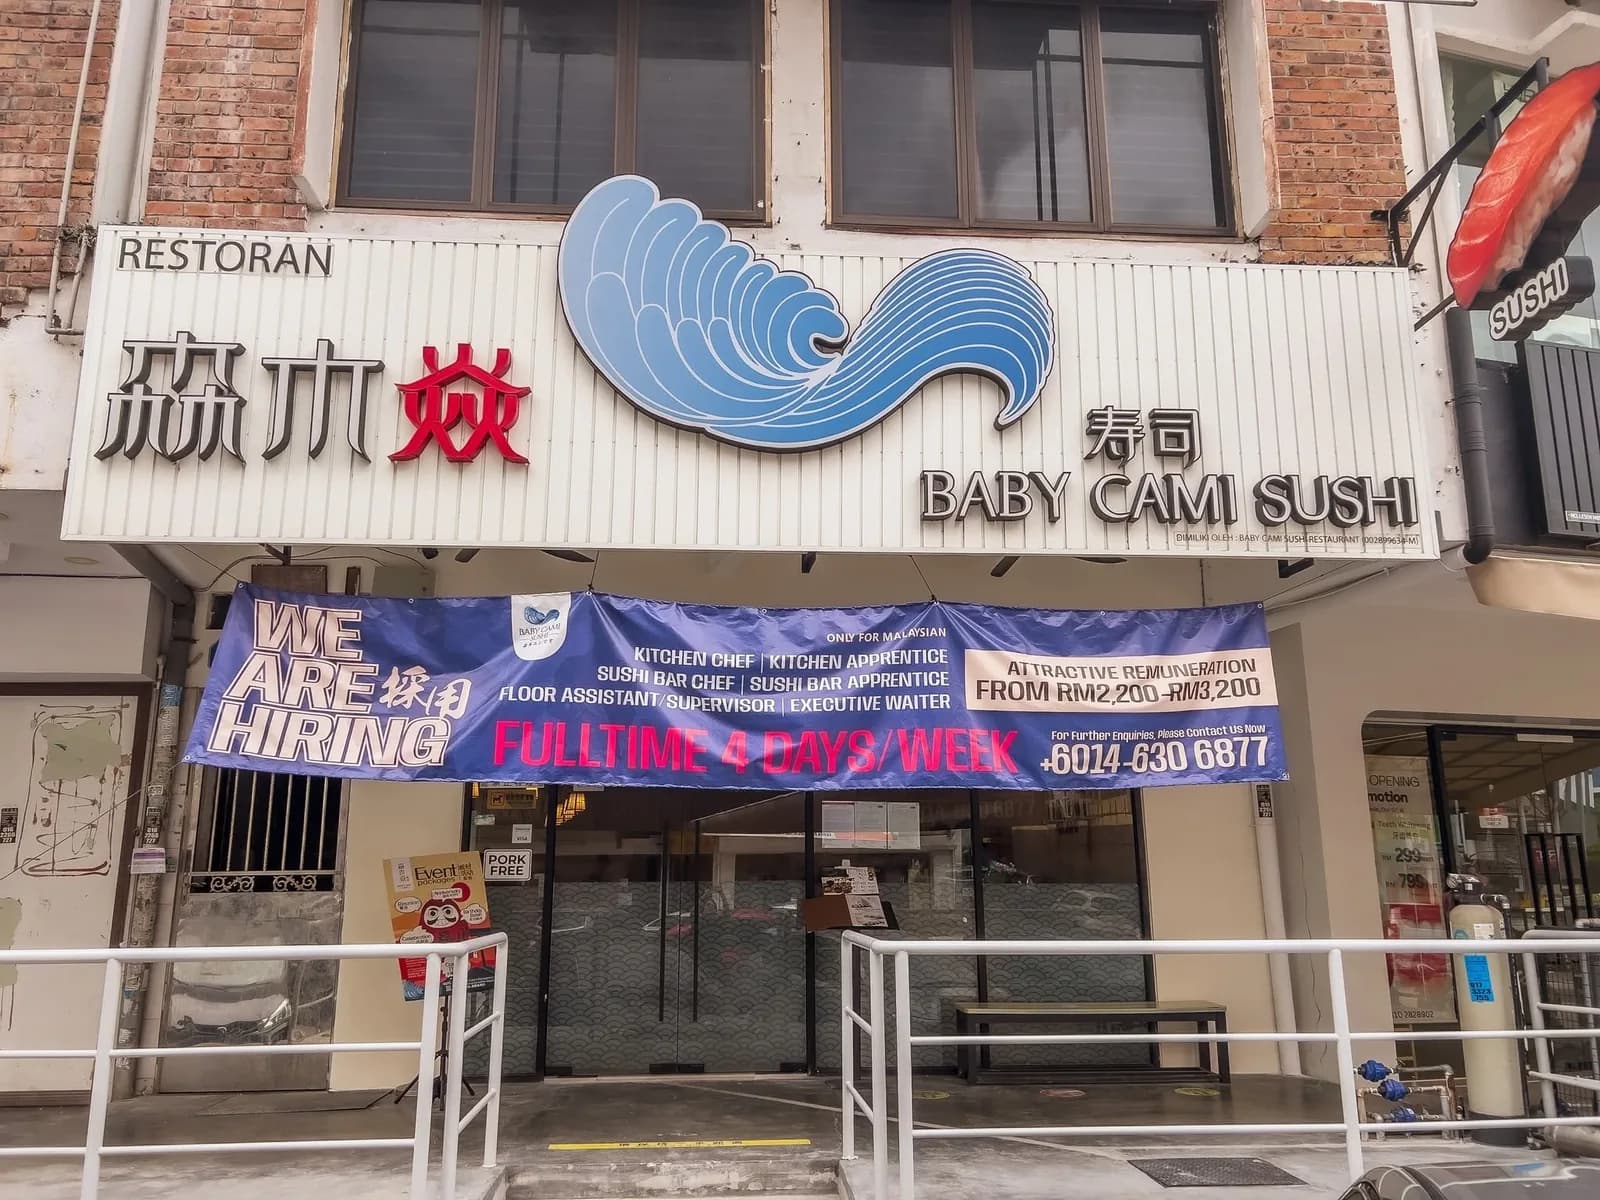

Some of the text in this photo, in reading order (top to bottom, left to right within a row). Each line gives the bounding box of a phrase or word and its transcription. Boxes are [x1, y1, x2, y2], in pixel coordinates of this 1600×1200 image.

[118, 238, 332, 276] RESTORAN
[1489, 256, 1569, 339] SUSHI
[1084, 405, 1201, 467] 寿司
[920, 470, 1419, 527] BABY CAMI SUSHI
[1176, 533, 1210, 542] DIMILIKI
[1211, 533, 1233, 543] OLEH
[1239, 534, 1260, 543] BABY
[1261, 535, 1283, 543] CAMI
[1284, 535, 1307, 544] SUSHI
[1308, 535, 1360, 545] RESTAURANT
[254, 598, 363, 661] WE
[826, 627, 947, 644] ONLY FOR MALAYSIAN
[634, 646, 949, 670] KITCHEN CHEF KITCHEN APPRENTICE
[1007, 657, 1257, 680] ATTRACTIVE REMUNERATION
[222, 650, 378, 715] ARE
[597, 665, 950, 692] SUSHI BAR CHEF SUSHI BAR APPRENTICE
[976, 679, 1050, 701] FROM
[379, 665, 474, 720] 採用
[499, 685, 951, 714] FLOOR ASSISTANT/SUPERVISOR EXECUTIVE WAITER
[207, 701, 452, 767] HIRING
[1051, 730, 1069, 741] For
[1071, 730, 1110, 742] Further
[1158, 728, 1185, 739] Please
[1186, 725, 1227, 737] Contact
[1229, 724, 1244, 735] Us
[1245, 723, 1267, 734] Now
[493, 719, 1019, 776] FULLTIME 4 DAYS/WEEK
[1040, 736, 1270, 775] +6014-630 6877
[1368, 774, 1420, 788] OPENING
[488, 854, 527, 865] PORK
[1394, 847, 1421, 863] 299
[415, 863, 457, 881] Event
[418, 876, 456, 887] packages
[490, 865, 525, 876] FREE
